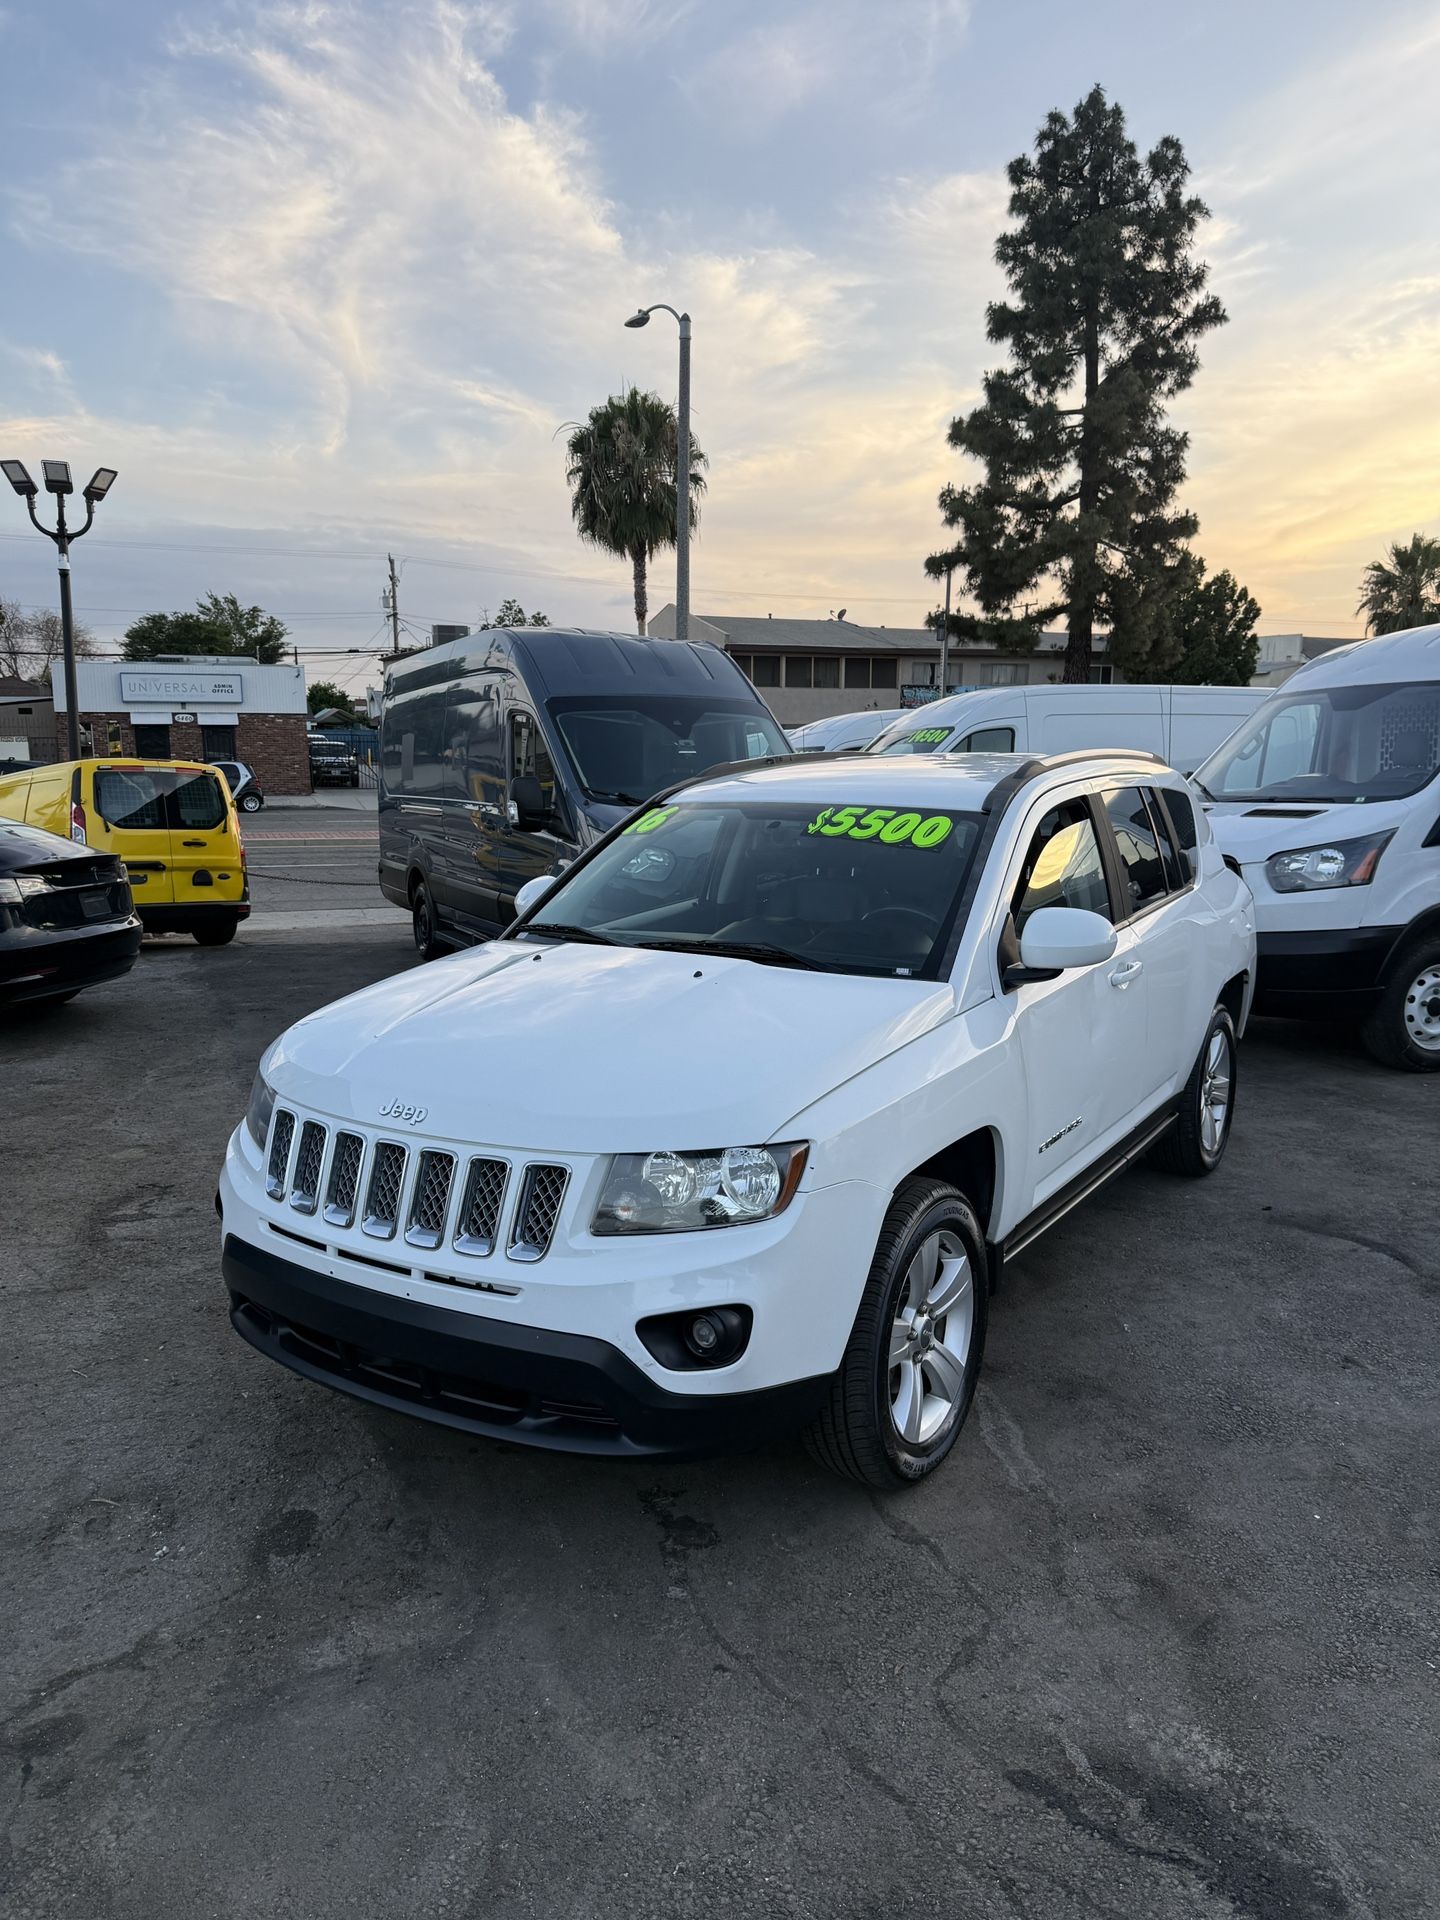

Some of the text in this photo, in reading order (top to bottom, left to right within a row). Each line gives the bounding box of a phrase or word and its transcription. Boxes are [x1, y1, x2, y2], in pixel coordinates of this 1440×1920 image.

[128, 682, 206, 694] UNIVERSAL
[807, 807, 953, 848] $5500
[378, 1096, 429, 1126] Jeep
